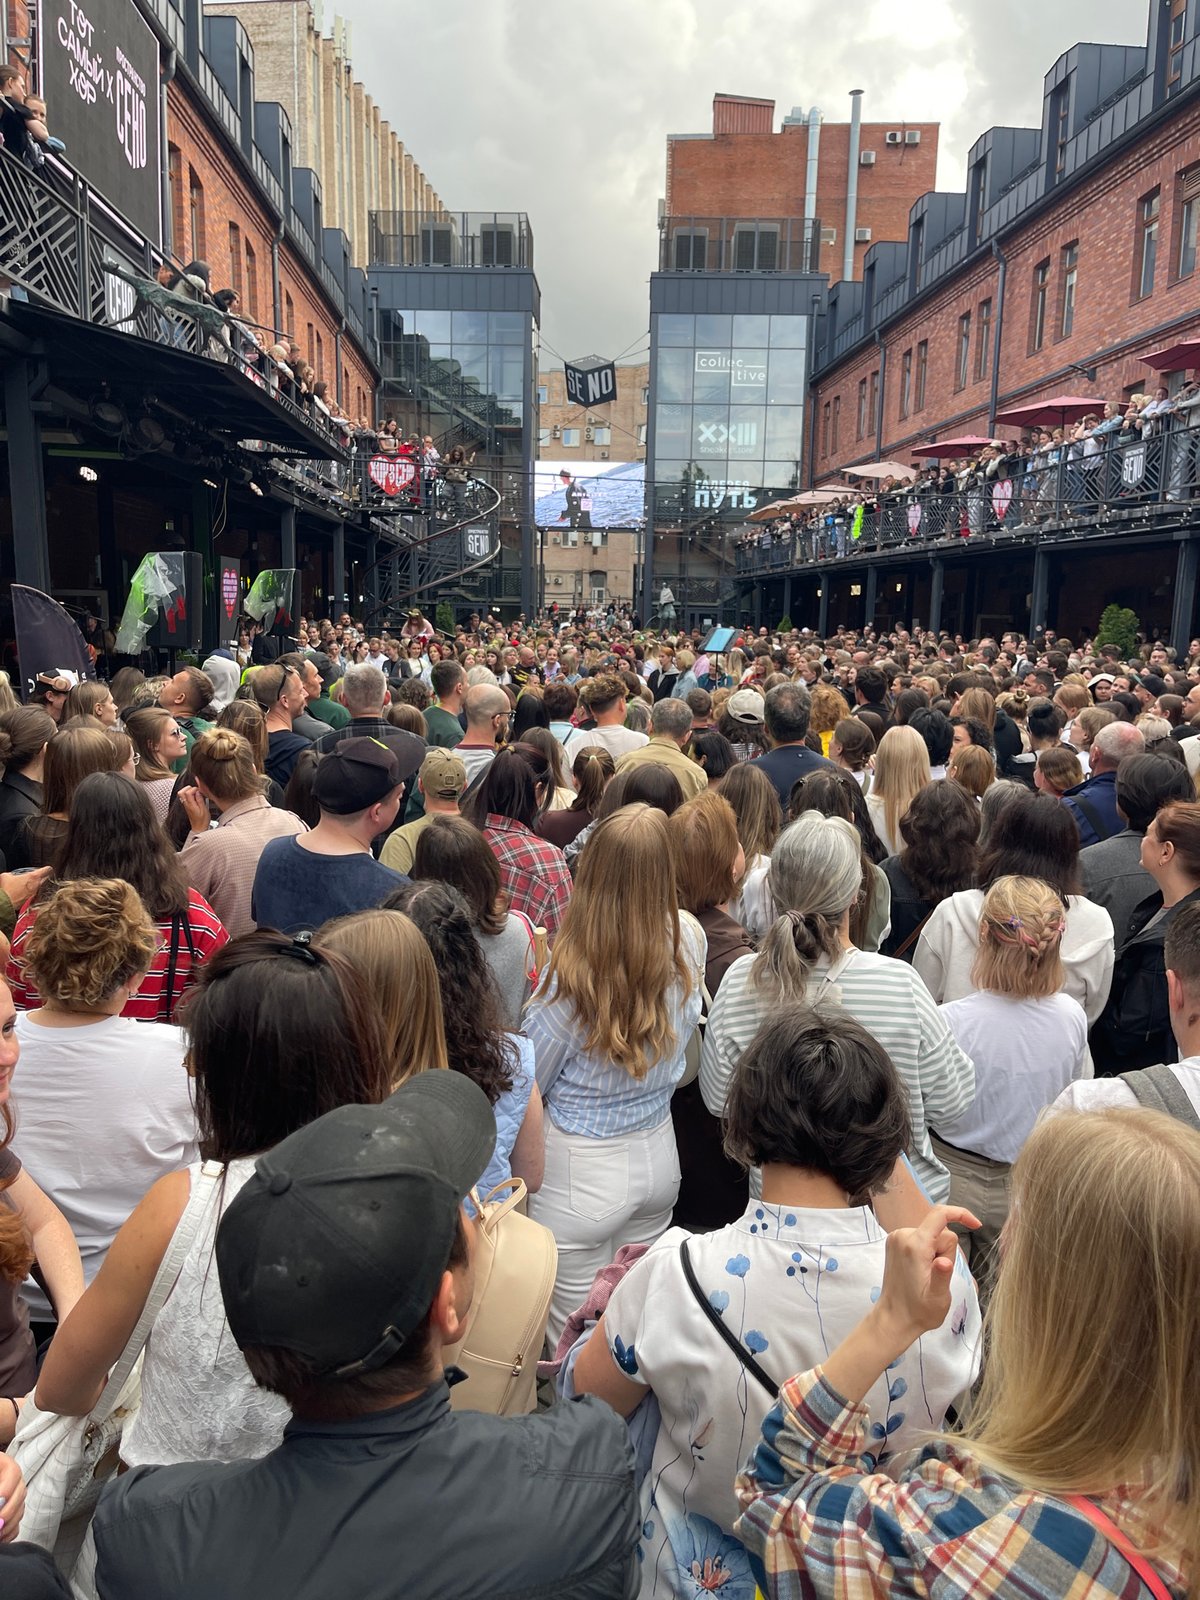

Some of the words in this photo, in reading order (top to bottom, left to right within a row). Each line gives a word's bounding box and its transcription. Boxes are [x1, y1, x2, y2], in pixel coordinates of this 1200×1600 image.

[69, 0, 95, 47] ТОТ
[58, 17, 104, 92] САМЫЙ
[69, 59, 96, 105] ХОР
[116, 70, 147, 169] СЕНО
[700, 357, 743, 368] collec
[737, 371, 766, 381] tive
[698, 423, 757, 446] XXIII
[1123, 455, 1143, 484] SENO
[695, 490, 757, 508] ПУТЬ
[468, 535, 490, 556] SENO
